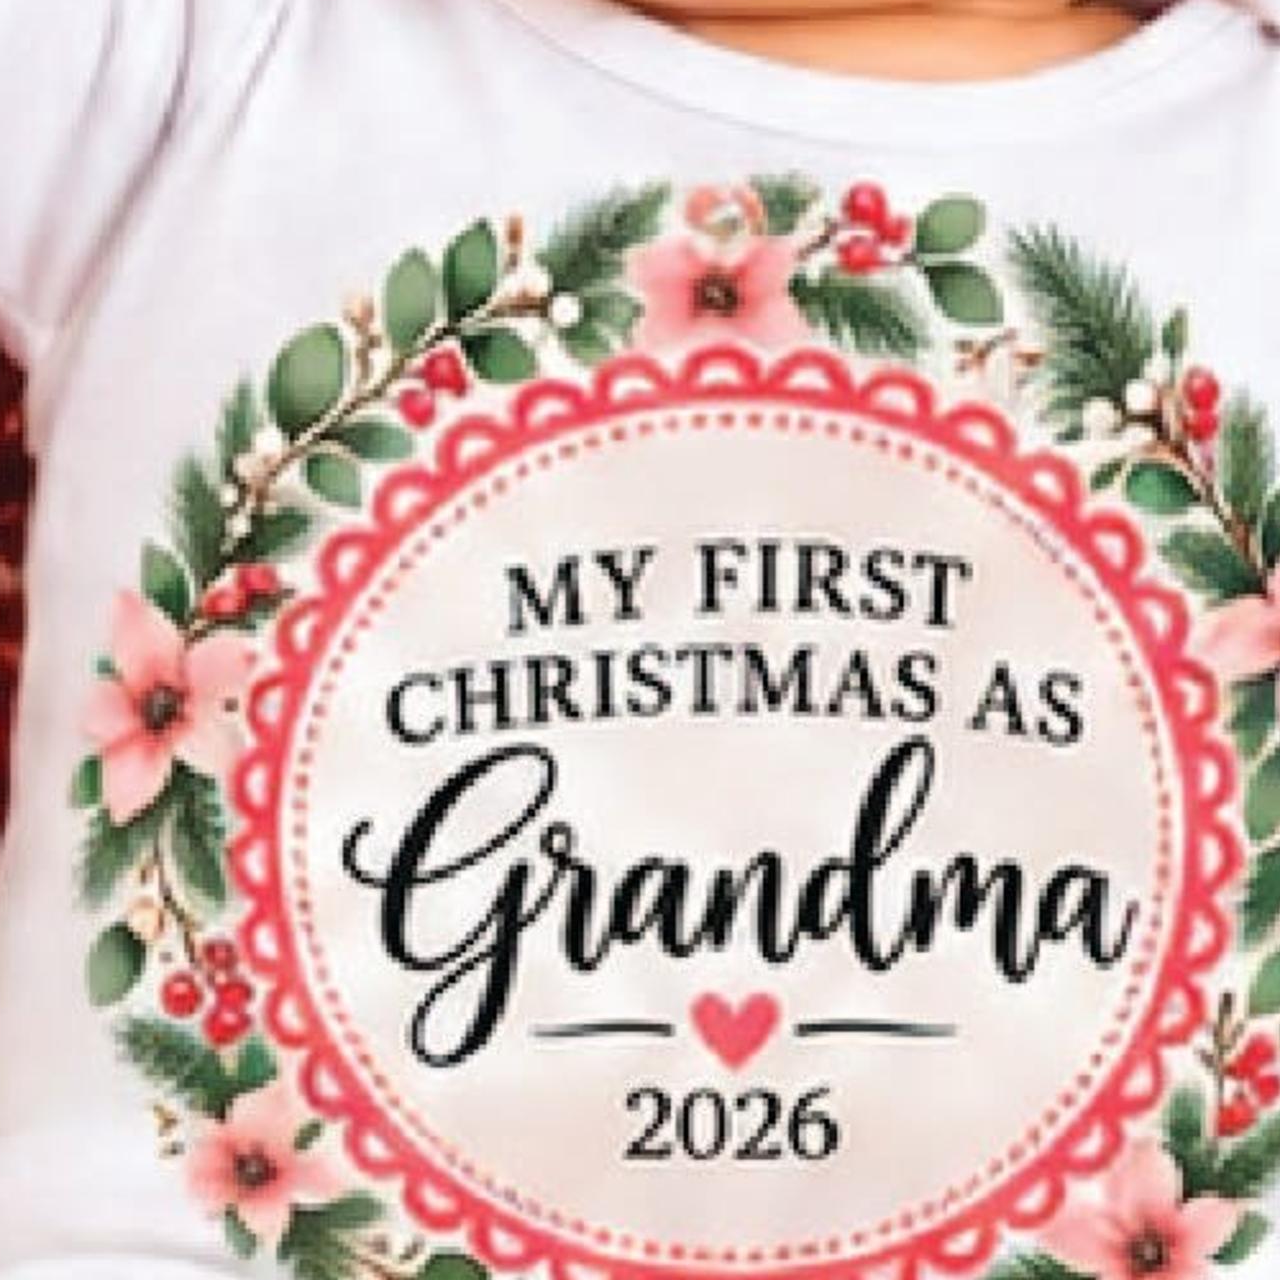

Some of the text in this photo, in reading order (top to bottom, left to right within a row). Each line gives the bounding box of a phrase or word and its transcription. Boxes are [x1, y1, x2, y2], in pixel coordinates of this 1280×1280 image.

[505, 538, 973, 634] MY FIRST
[384, 644, 1084, 746] CHRISTMAS AS
[341, 733, 1137, 1069] Grandma
[623, 1086, 841, 1162] 2026
